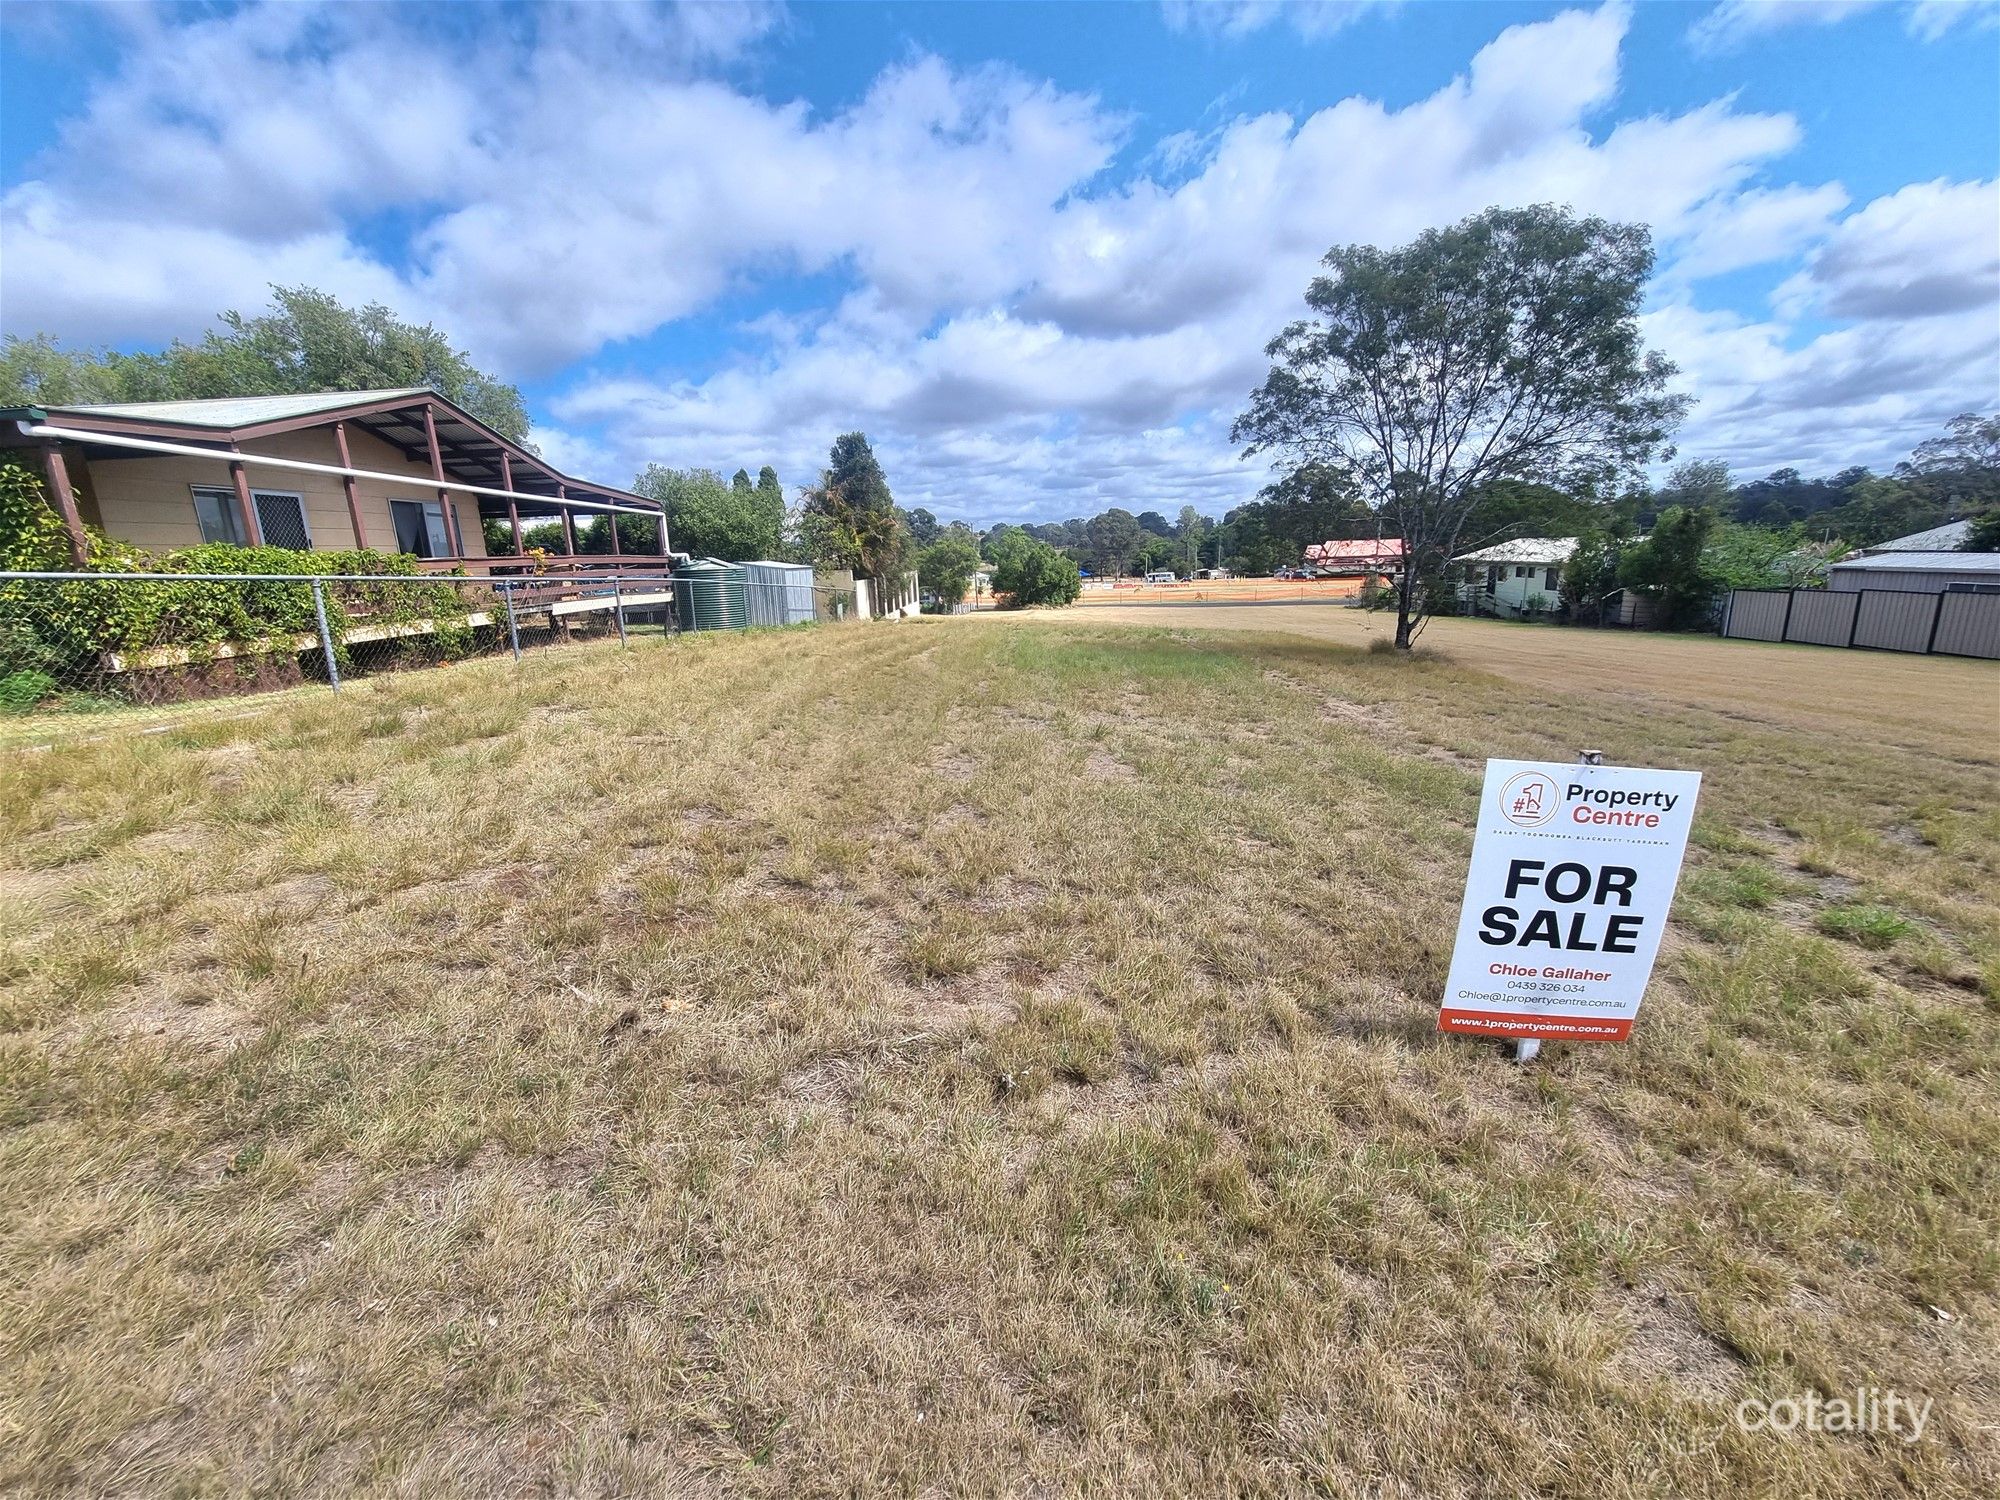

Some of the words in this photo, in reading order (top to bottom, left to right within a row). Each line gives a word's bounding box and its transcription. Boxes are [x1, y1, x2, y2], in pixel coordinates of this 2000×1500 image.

[1566, 784, 1679, 811] Property
[1572, 805, 1660, 828] Centre
[1504, 859, 1638, 907] FOR
[1478, 905, 1645, 954] SALE
[1489, 963, 1538, 978] Chloe
[1542, 967, 1612, 982] Gallaher
[1507, 980, 1537, 991] 0439
[1538, 982, 1561, 992] 326
[1563, 984, 1586, 993] 034
[1458, 990, 1627, 1008] Chloe@1propertycentre.com.au
[1451, 1017, 1619, 1034] www.1propertycentre.com.au
